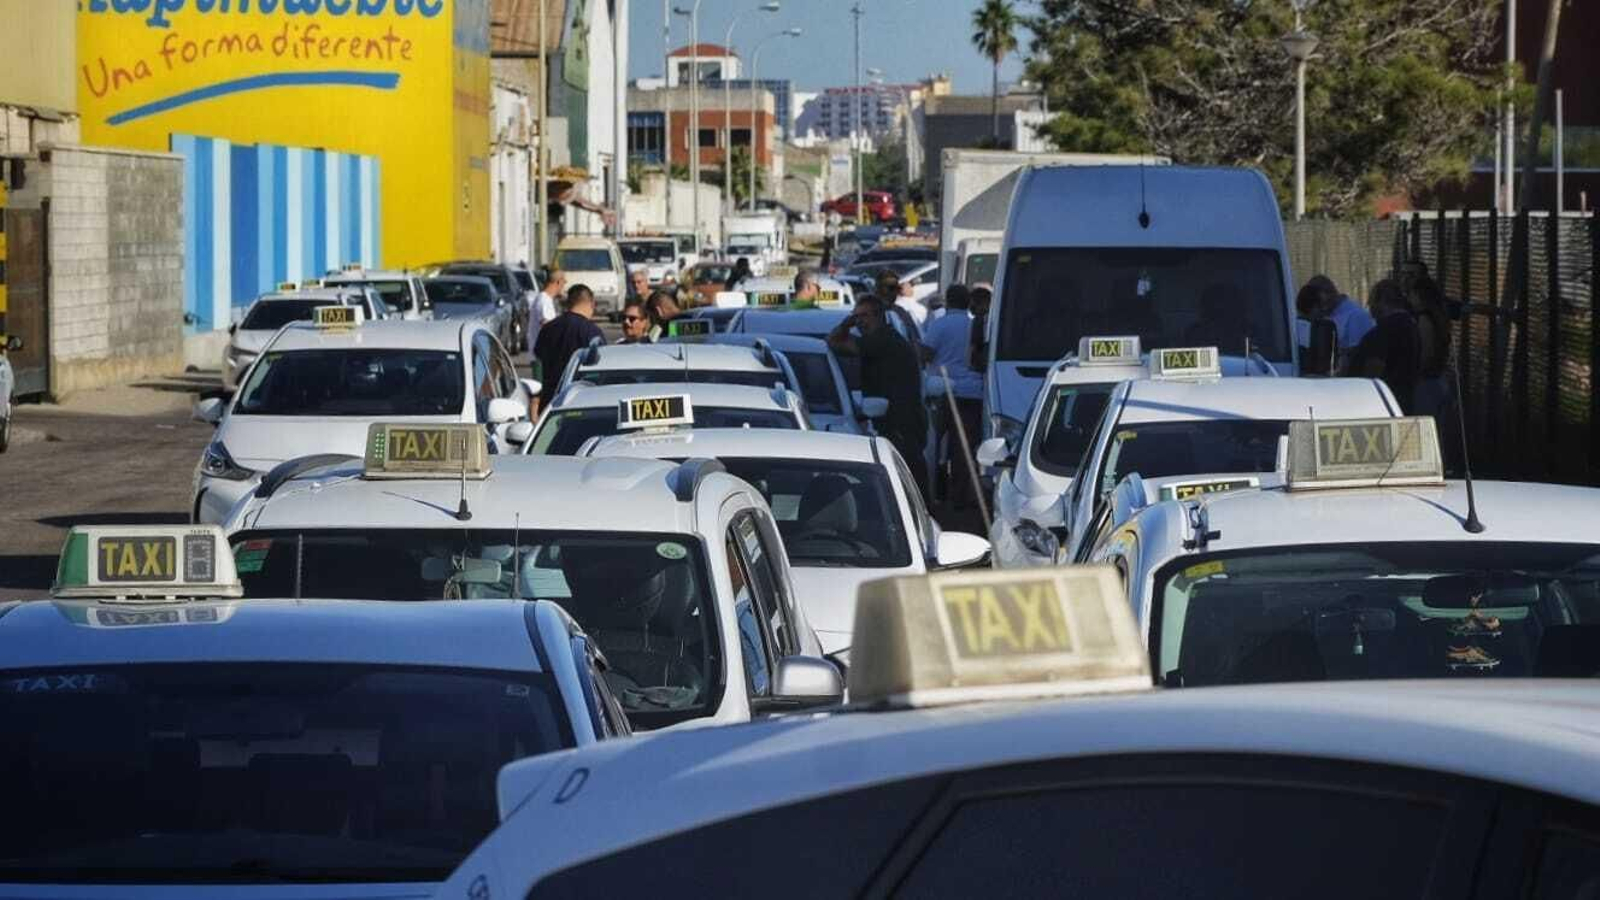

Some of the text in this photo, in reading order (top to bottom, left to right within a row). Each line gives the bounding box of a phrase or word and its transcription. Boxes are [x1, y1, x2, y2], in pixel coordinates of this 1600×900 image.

[83, 21, 413, 98] Una forma diferente
[322, 309, 347, 323] TAXI
[1093, 341, 1121, 356] TAXI
[1164, 352, 1197, 368] TAXI
[632, 399, 669, 419] TAXI
[391, 431, 446, 459] TAXI
[1320, 426, 1389, 463] TAXI
[101, 541, 174, 577] TAXI
[943, 583, 1071, 655] TAXI
[13, 673, 97, 692] TAXI
